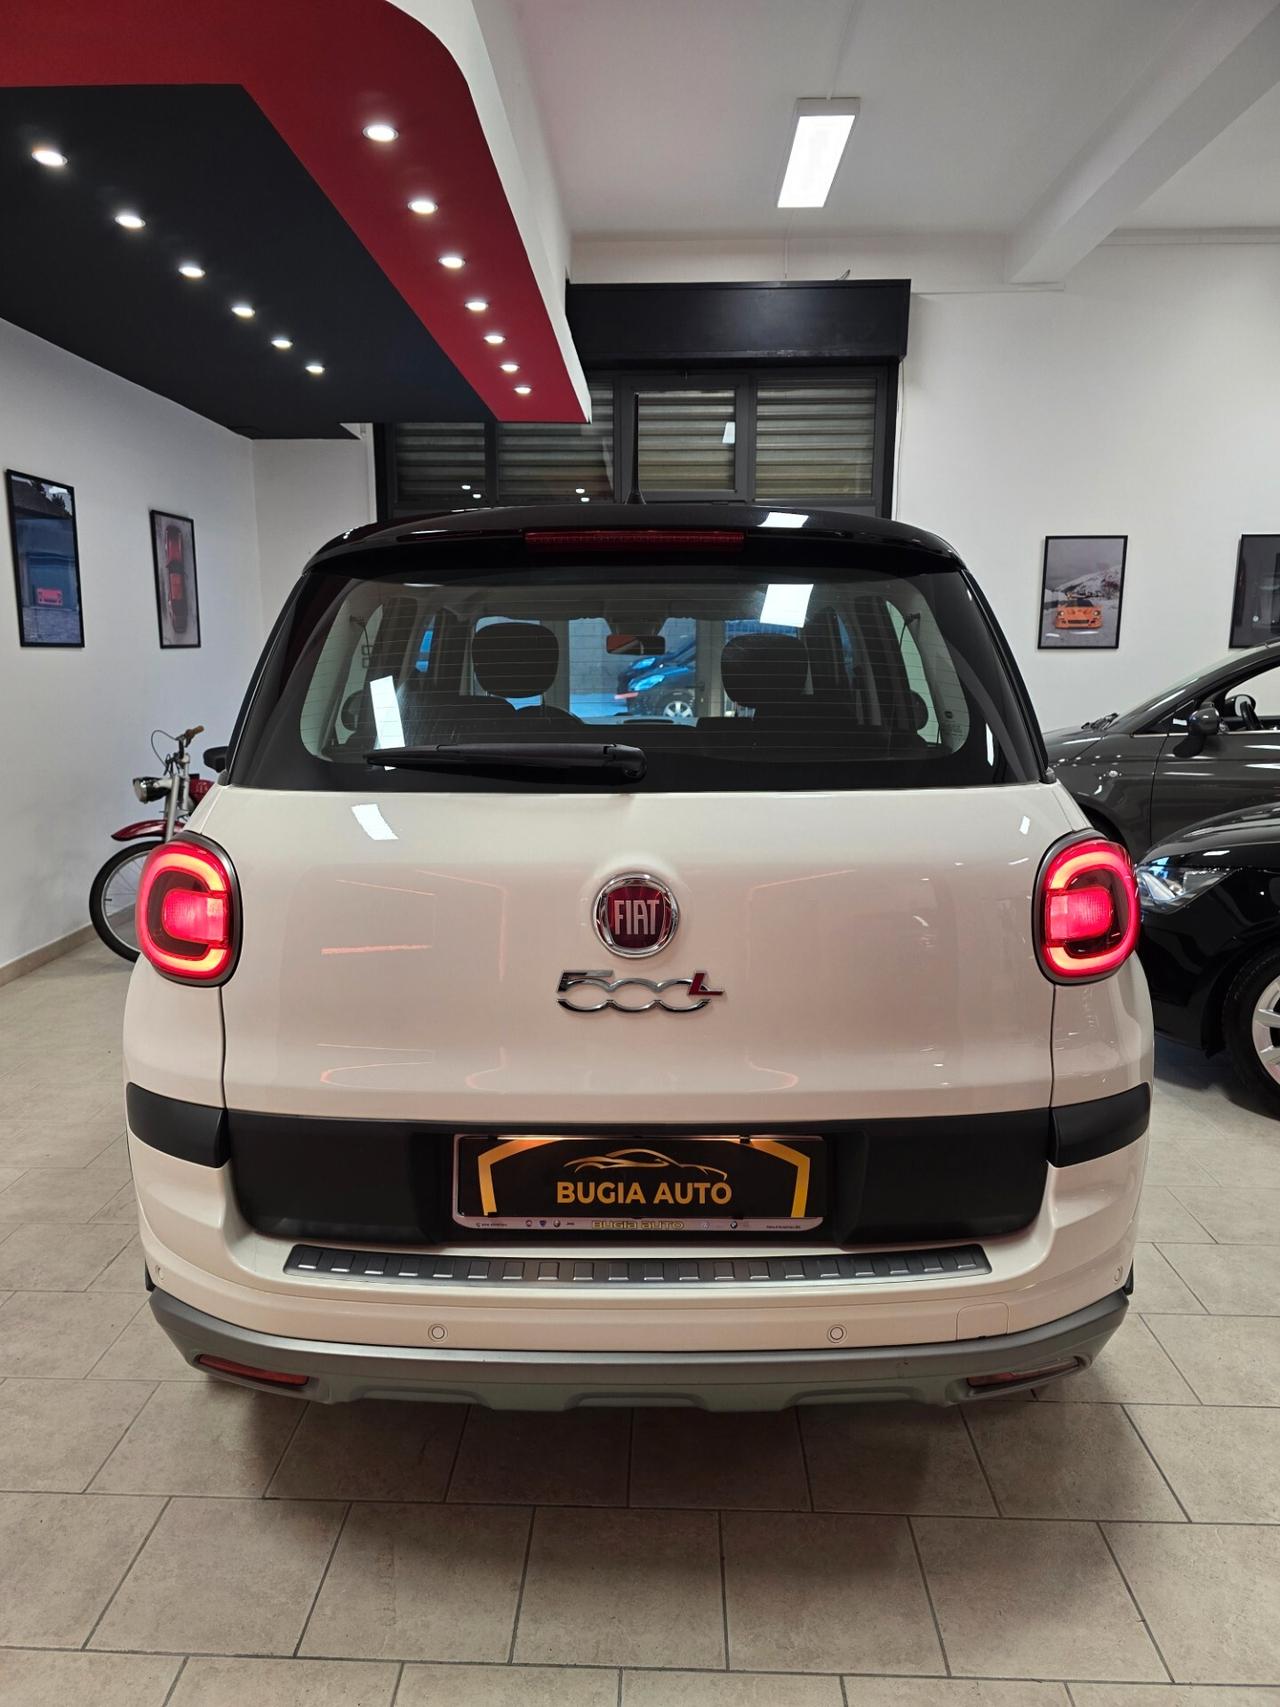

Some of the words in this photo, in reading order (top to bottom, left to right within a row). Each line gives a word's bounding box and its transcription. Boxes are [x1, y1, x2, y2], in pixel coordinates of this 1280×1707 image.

[613, 899, 660, 935] FIAT
[556, 1181, 647, 1205] BUGIA
[653, 1181, 733, 1205] AUTO
